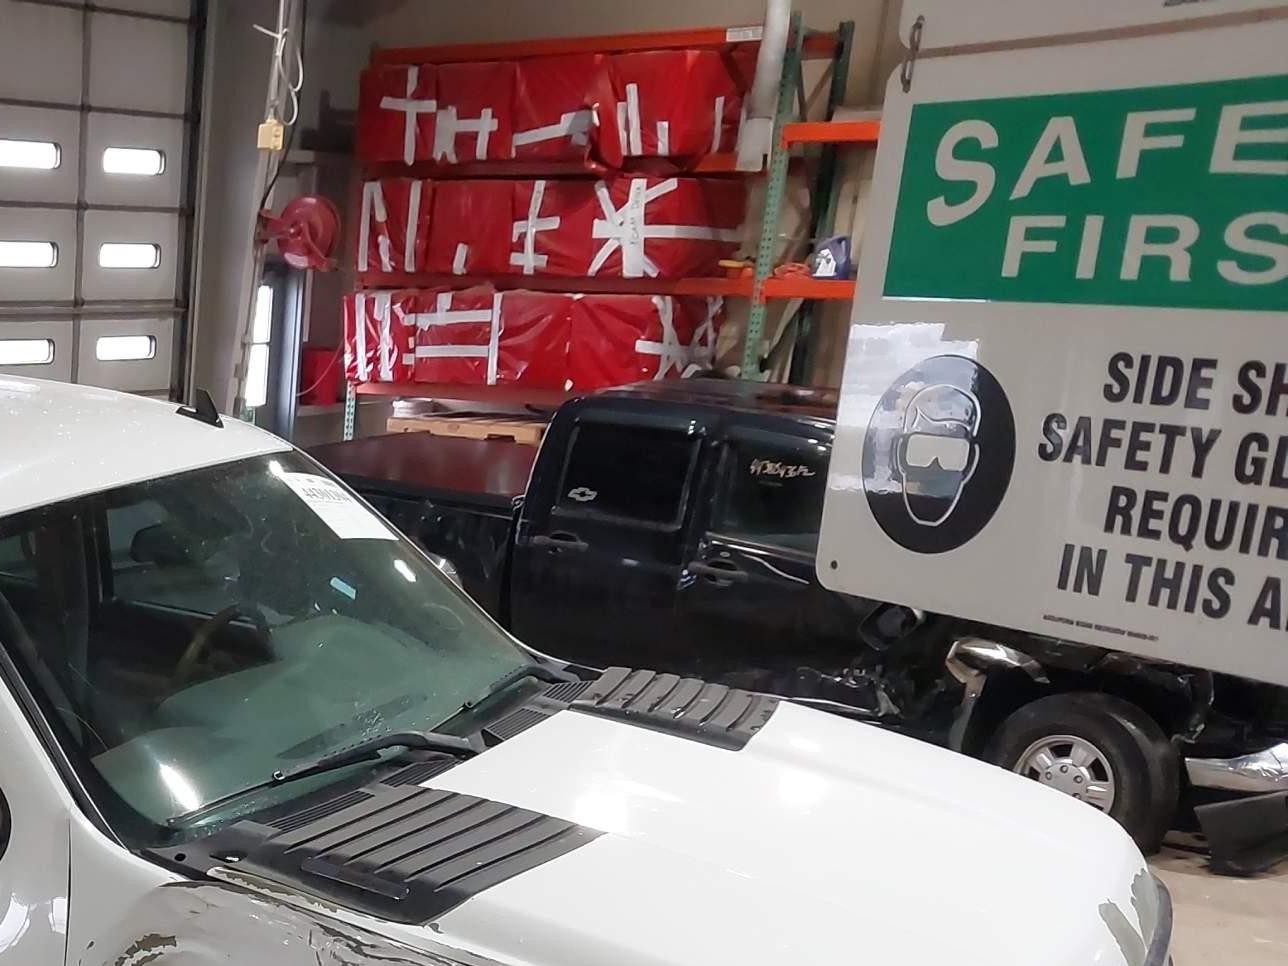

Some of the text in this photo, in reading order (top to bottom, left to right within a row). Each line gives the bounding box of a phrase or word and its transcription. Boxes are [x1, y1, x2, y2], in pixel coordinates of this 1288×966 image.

[926, 101, 1288, 227] SAFE
[1001, 211, 1288, 285] FIRS
[1103, 352, 1218, 410] SIDE
[1038, 413, 1222, 479] SAFETY
[1104, 485, 1288, 561] REQUIR
[1057, 543, 1288, 632] IN THIS A
